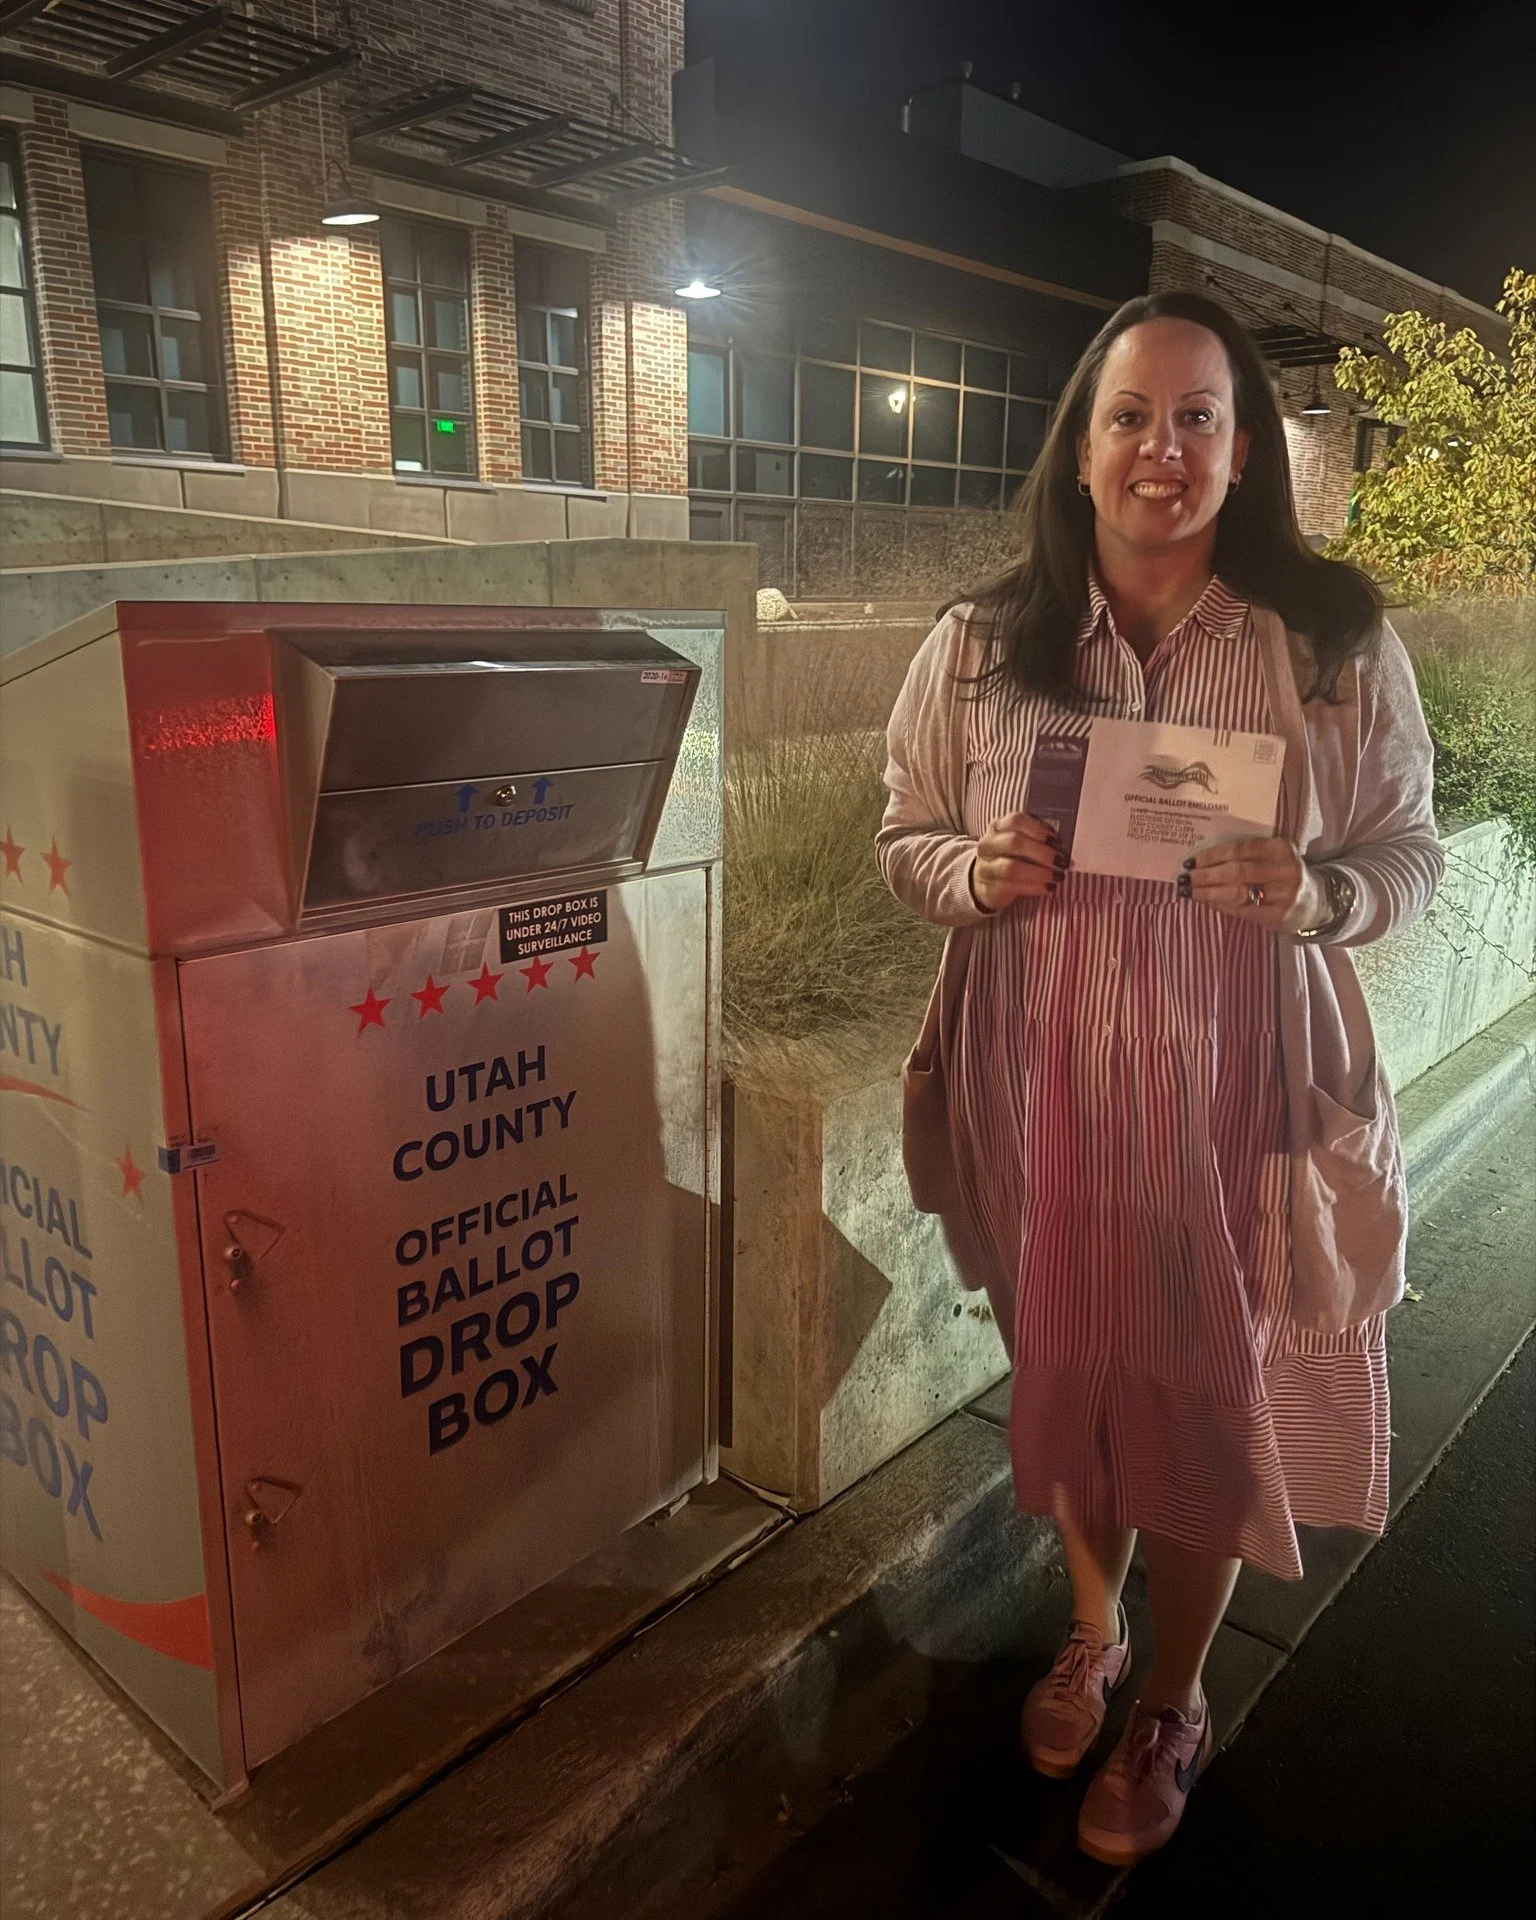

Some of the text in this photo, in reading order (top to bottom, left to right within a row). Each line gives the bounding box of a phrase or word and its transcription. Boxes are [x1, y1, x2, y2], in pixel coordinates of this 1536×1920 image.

[412, 804, 574, 838] PUSH TO DEPOSIT
[1124, 794, 1156, 804] OFFICIAL
[1158, 798, 1186, 808] BALLOT
[506, 912, 602, 940] UNDER 24/7 VIDEO
[508, 897, 598, 924] THIS DROP BOX IS
[518, 929, 593, 955] SURVEILLANCE
[426, 1044, 546, 1112] UTAH
[392, 1089, 578, 1183] COUNTY
[395, 1173, 579, 1267] OFFICIAL
[397, 1215, 580, 1328] BALLOT
[400, 1271, 581, 1399] DROP
[428, 1342, 560, 1457] BOX
